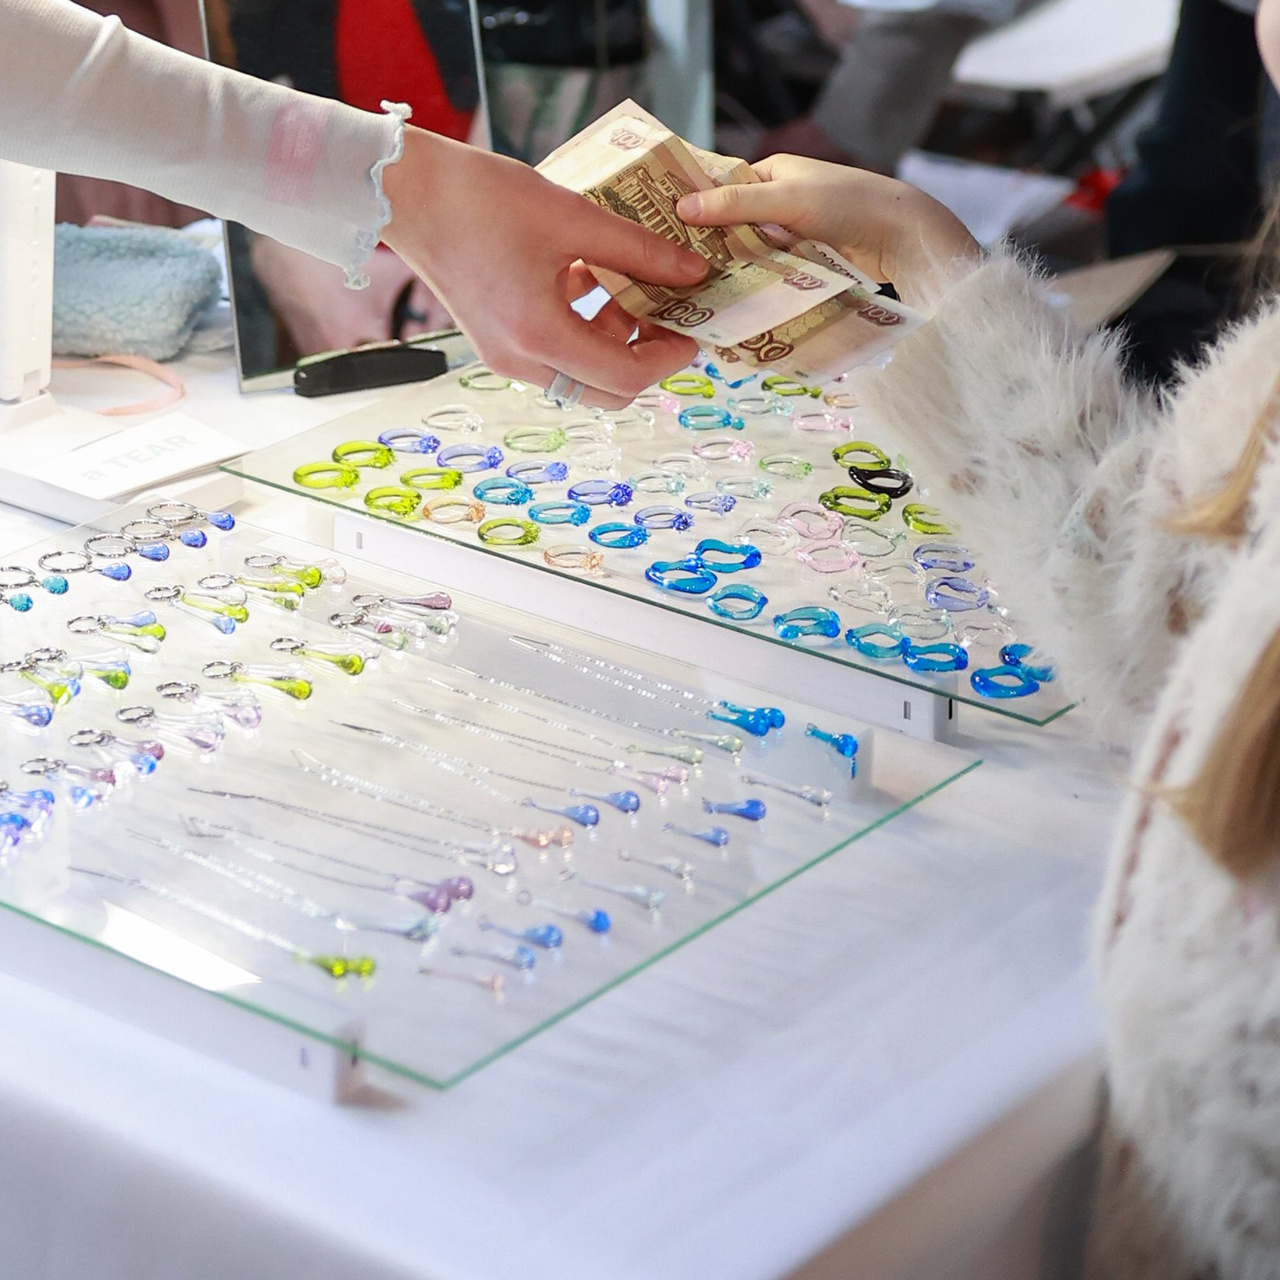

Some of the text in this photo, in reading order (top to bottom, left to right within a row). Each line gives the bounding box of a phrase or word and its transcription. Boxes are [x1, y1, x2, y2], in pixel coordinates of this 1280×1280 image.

[783, 271, 823, 290] 100
[647, 298, 715, 328] 100
[857, 303, 902, 326] 100
[738, 329, 794, 362] 00
[81, 434, 199, 482] a TEAR
